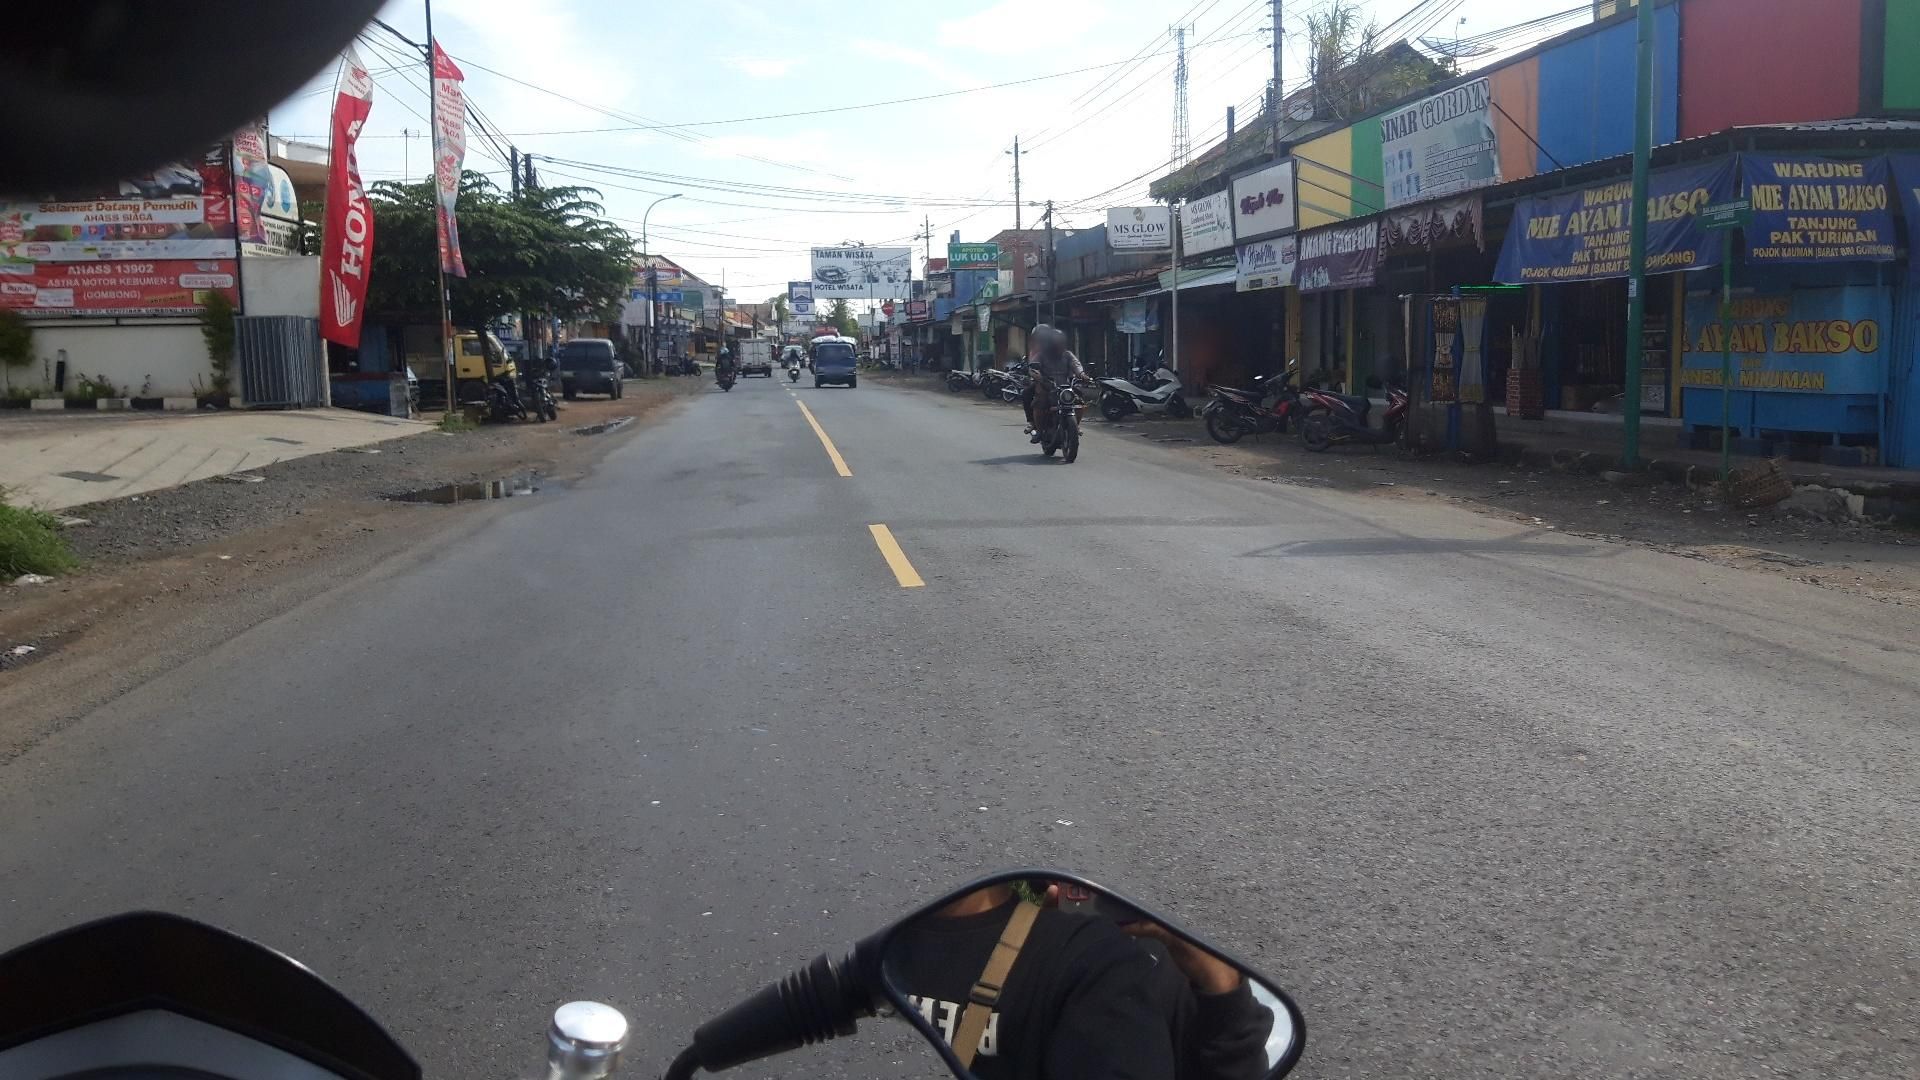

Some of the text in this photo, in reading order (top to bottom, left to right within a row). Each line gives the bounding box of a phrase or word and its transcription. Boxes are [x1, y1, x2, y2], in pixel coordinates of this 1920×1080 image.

[1421, 81, 1490, 129] GORDYN
[1773, 163, 1863, 178] WARUNG
[1584, 185, 1632, 205] WARUN
[1752, 185, 1784, 211] MIE
[1788, 184, 1833, 210] AYAM
[1836, 183, 1887, 211] BAKSO
[39, 200, 198, 214] Selamat Datang Pemudik
[1527, 188, 1710, 239] MIE AYAM AKSO
[84, 213, 153, 223] AHASS SIAGA
[1787, 217, 1857, 230] TANJUNG
[1113, 223, 1166, 234] MS GLOW
[1584, 232, 1631, 248] TANJUNG
[1770, 230, 1877, 244] PAK TURIMAN
[815, 250, 874, 260] TAMAN WISATA
[949, 253, 969, 262] LUK
[970, 253, 989, 262] ULO
[1572, 252, 1591, 264] PAK
[1753, 248, 1780, 258] POJOK
[1782, 247, 1813, 257] KAUMAN
[67, 263, 154, 275] AHASS 13902
[1521, 267, 1550, 278] POJOK
[1551, 265, 1589, 277] KAUMAN
[1591, 263, 1622, 276] (BARAT
[48, 278, 79, 288] ASTRA
[82, 278, 116, 287] MOTOR
[119, 276, 166, 286] KEBUMEN
[169, 277, 175, 285] 2
[83, 290, 141, 301] (GOMBONG)
[1773, 320, 1879, 353] BAKSO
[1740, 369, 1825, 390] MINUMAN
